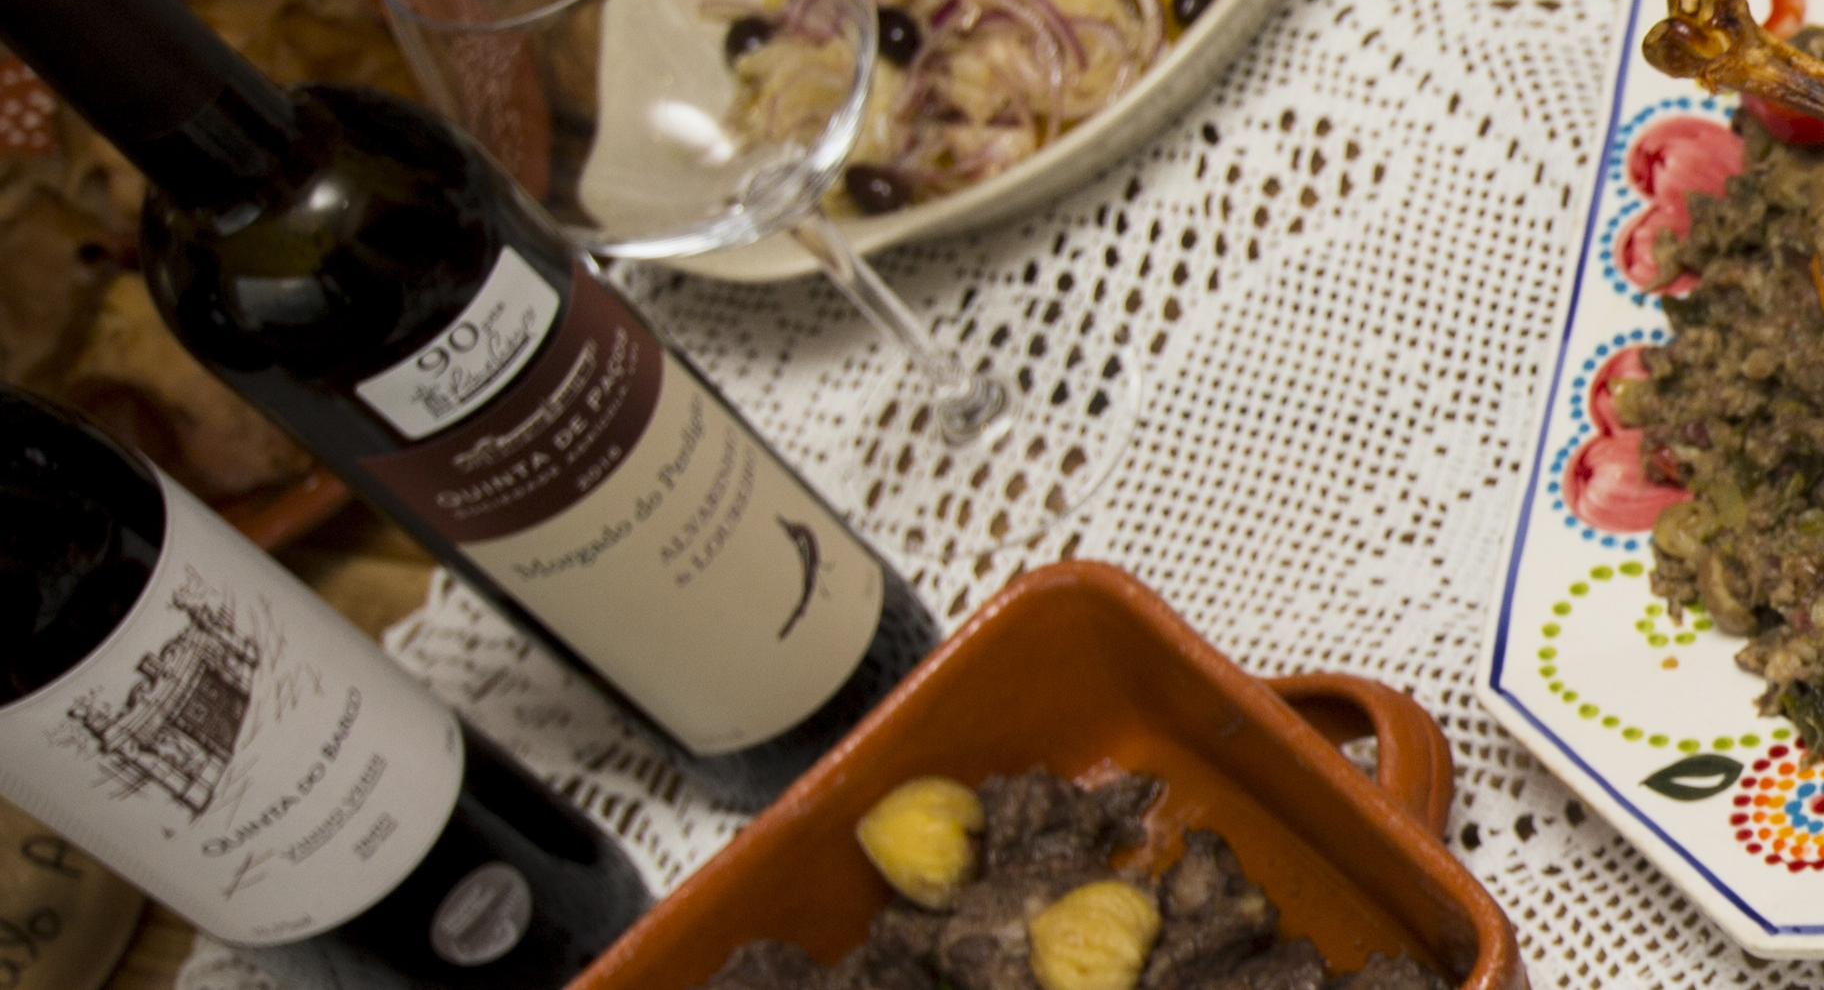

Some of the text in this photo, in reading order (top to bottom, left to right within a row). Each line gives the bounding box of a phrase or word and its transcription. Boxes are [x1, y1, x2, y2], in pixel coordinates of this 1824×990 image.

[416, 320, 479, 379] 90
[435, 451, 550, 507] QUINTA
[554, 414, 590, 450] DE
[659, 426, 738, 565] ALVARINHO
[514, 519, 633, 581] Morgado
[634, 490, 664, 525] do
[202, 795, 301, 858] QUINTA
[297, 761, 326, 795] DO
